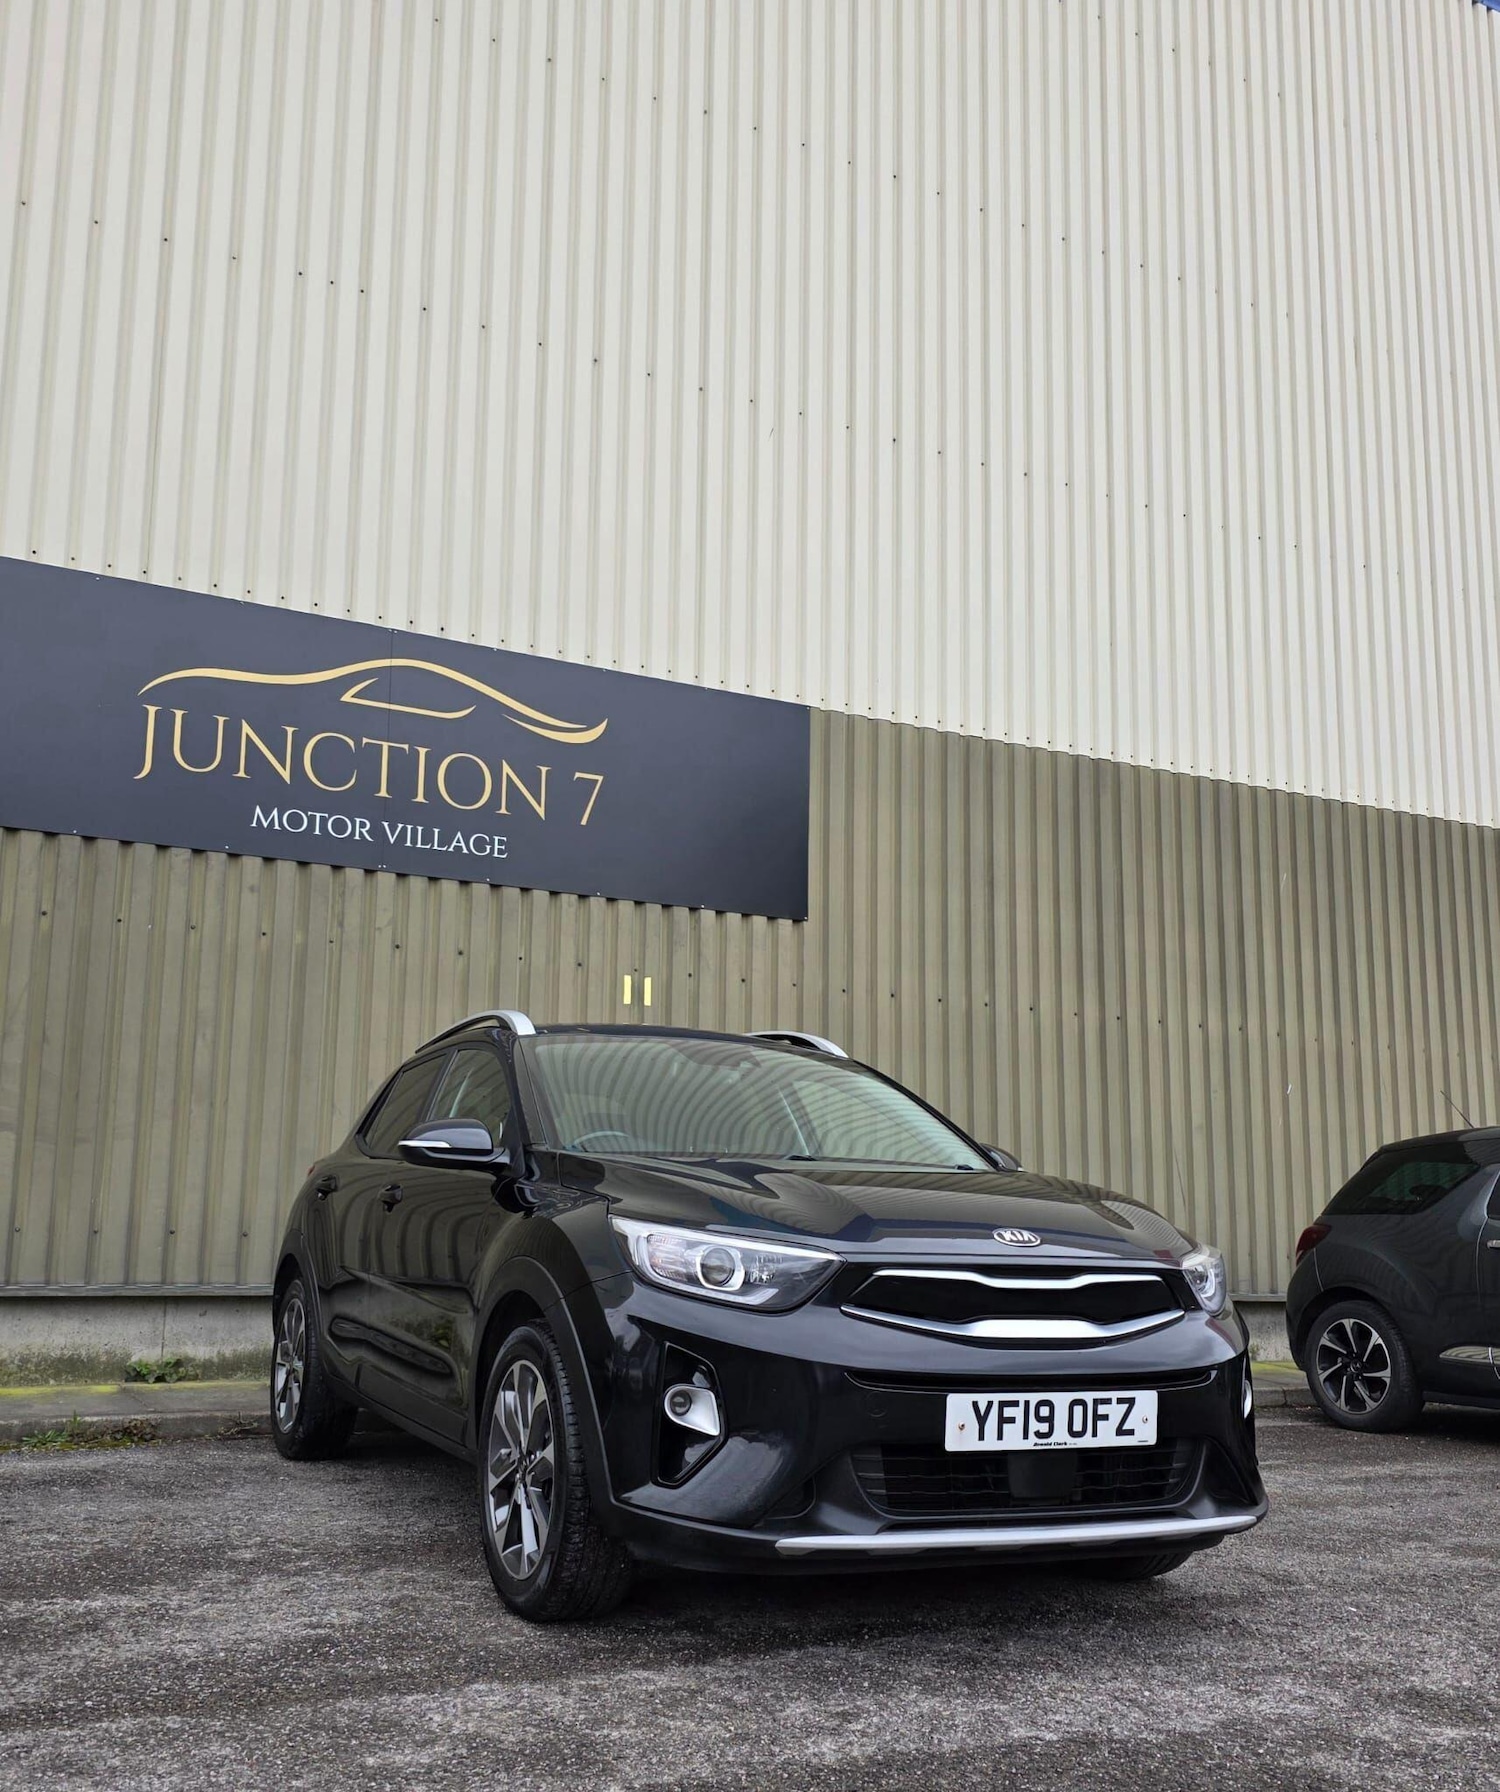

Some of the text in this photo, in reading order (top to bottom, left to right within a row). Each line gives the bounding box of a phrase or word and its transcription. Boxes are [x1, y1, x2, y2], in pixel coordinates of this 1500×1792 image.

[133, 704, 605, 826] JUNCTION 7
[250, 804, 509, 859] MOTOR VILLAGE
[999, 1229, 1038, 1243] KIA
[971, 1397, 1136, 1441] YF19 OFZ
